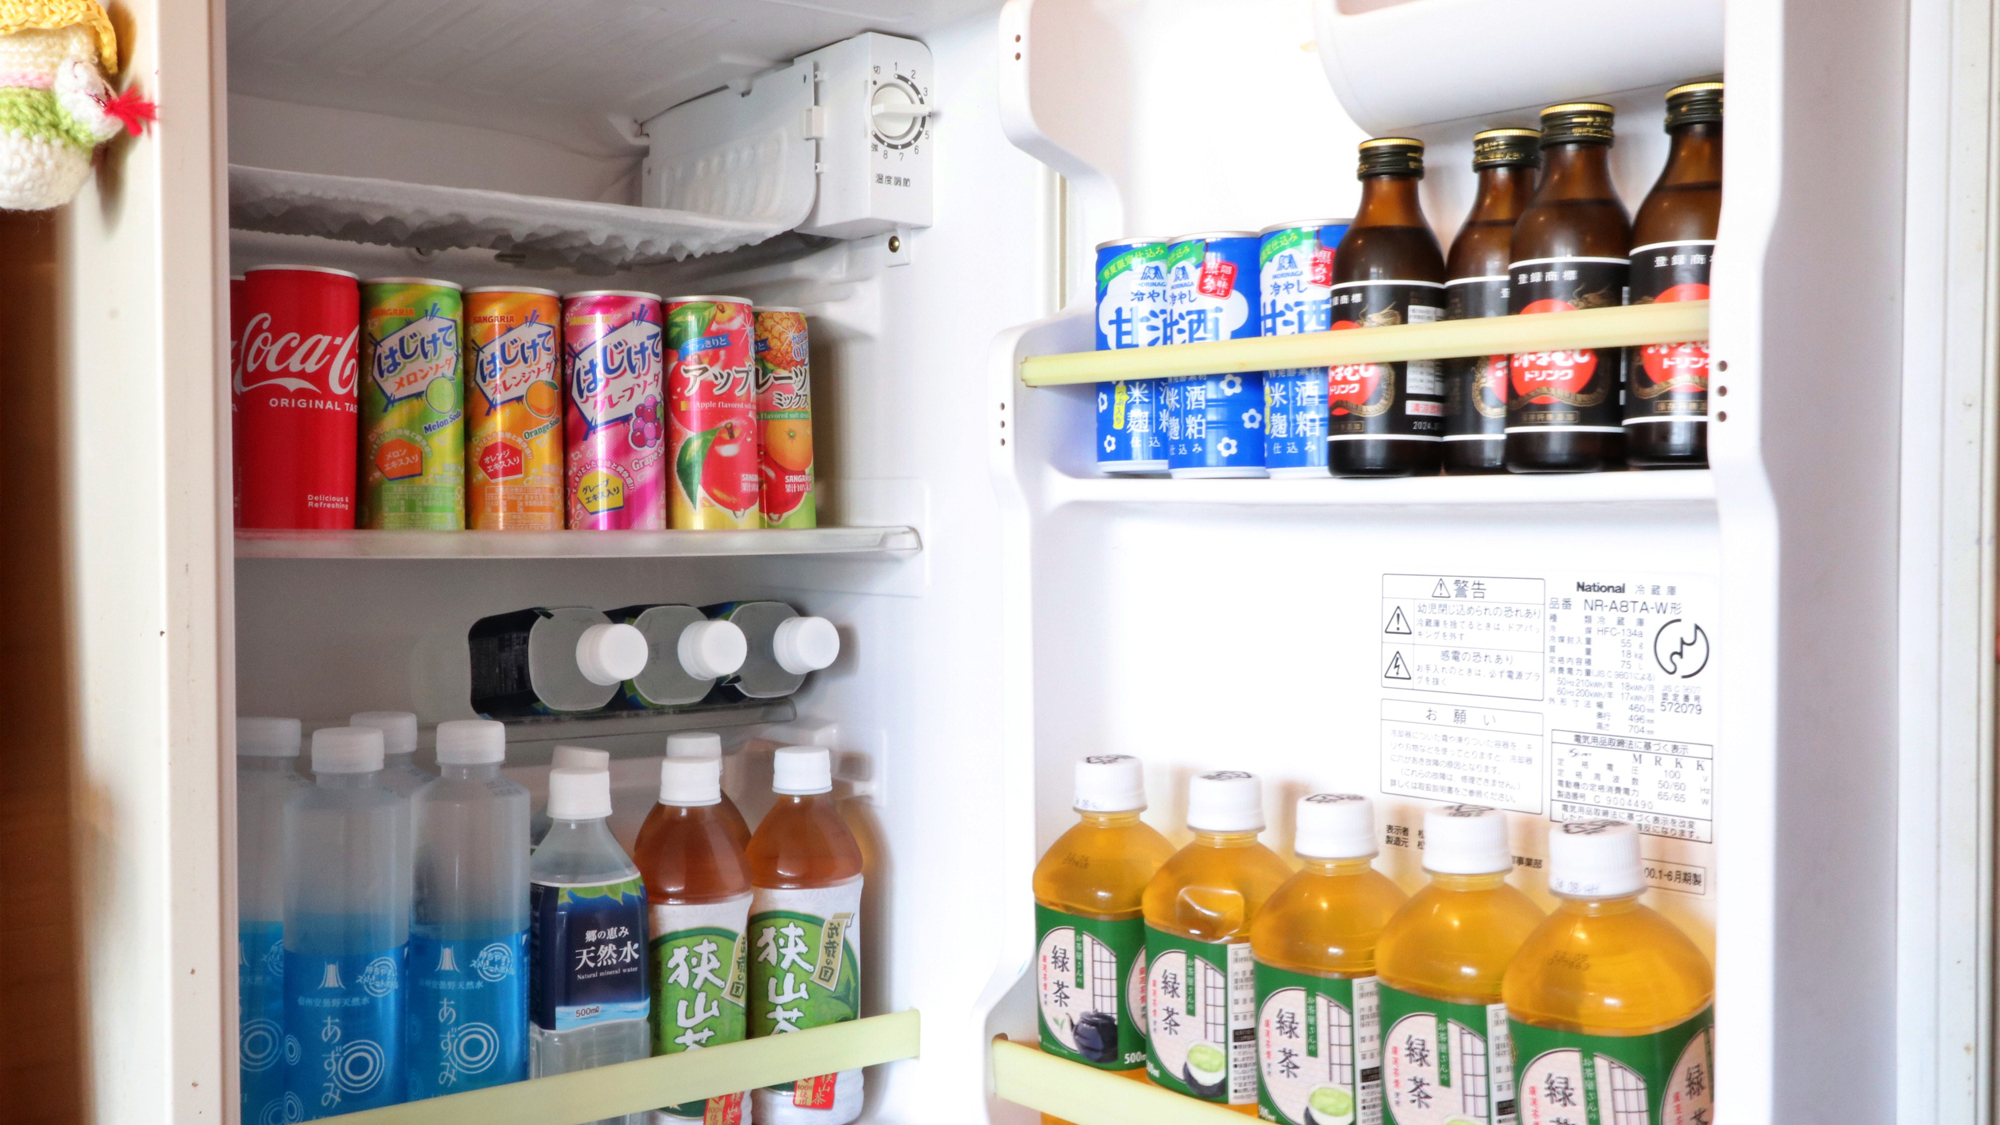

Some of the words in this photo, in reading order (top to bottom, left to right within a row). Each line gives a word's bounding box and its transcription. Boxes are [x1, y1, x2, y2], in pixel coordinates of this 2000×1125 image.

[1654, 253, 1713, 268] 登録商
[1517, 269, 1579, 285] 登録商標
[1270, 279, 1308, 297] 冷やし
[1169, 289, 1198, 306] 冷やし
[474, 315, 515, 323] SANGARIA
[233, 313, 359, 397] Coca-C
[377, 325, 453, 379] はじけて
[480, 330, 552, 384] はじけて
[576, 331, 660, 400] はじけて
[394, 356, 454, 393] メロンソーダ
[490, 360, 554, 396] オレンジソーダ
[1524, 369, 1575, 382] ドリンク
[269, 398, 342, 410] ORIGINAL
[345, 403, 358, 413] TAS
[1185, 384, 1206, 440] 酒粕
[1295, 380, 1320, 437] 酒粕
[423, 420, 449, 434] Melon
[523, 423, 551, 440] Orange
[386, 449, 407, 461] メロン
[1273, 441, 1317, 454] 仕込み
[484, 449, 510, 465] オレンジ
[487, 456, 520, 473] エキス入り
[632, 454, 659, 472] Grape
[582, 478, 609, 495] グレープ
[307, 494, 344, 503] Delicious
[585, 486, 620, 504] エキス入り
[308, 502, 349, 510] Refreshing
[1454, 579, 1487, 599] 警告
[1576, 581, 1626, 594] National
[1549, 597, 1572, 610] 品番
[1596, 627, 1644, 638] HFC-134a
[1620, 639, 1632, 648] 55
[1441, 649, 1514, 665] 感電の恐れあり
[1621, 650, 1632, 659] 18
[1634, 651, 1644, 661] kg
[1620, 660, 1632, 670] 75
[1628, 704, 1646, 714] 460
[1660, 701, 1703, 715] 572079
[1628, 714, 1646, 724] 496
[1628, 724, 1646, 735] 704
[1574, 734, 1689, 755] 電気用品取締法に基づく表示
[1664, 770, 1681, 780] 100
[1657, 780, 1687, 792] 50/60
[1557, 790, 1587, 801] 製造番号
[1657, 791, 1687, 803] 65/65
[1386, 824, 1410, 837] 表示者
[1385, 835, 1409, 848] 製造元
[585, 926, 629, 943] 郷の恵み
[575, 941, 639, 971] 天然水
[577, 971, 598, 980] Natural
[599, 968, 621, 977] mineral
[622, 966, 638, 974] water
[1051, 944, 1071, 1008] 緑茶
[1160, 968, 1181, 1036] 緑茶
[438, 998, 458, 1088] あずみ
[1275, 1008, 1301, 1078] 緑茶
[321, 1015, 343, 1109] あずみ
[1124, 1051, 1147, 1064] 500m
[1404, 1034, 1433, 1110] 緑茶
[1582, 1057, 1597, 1120] お茶屋さんの
